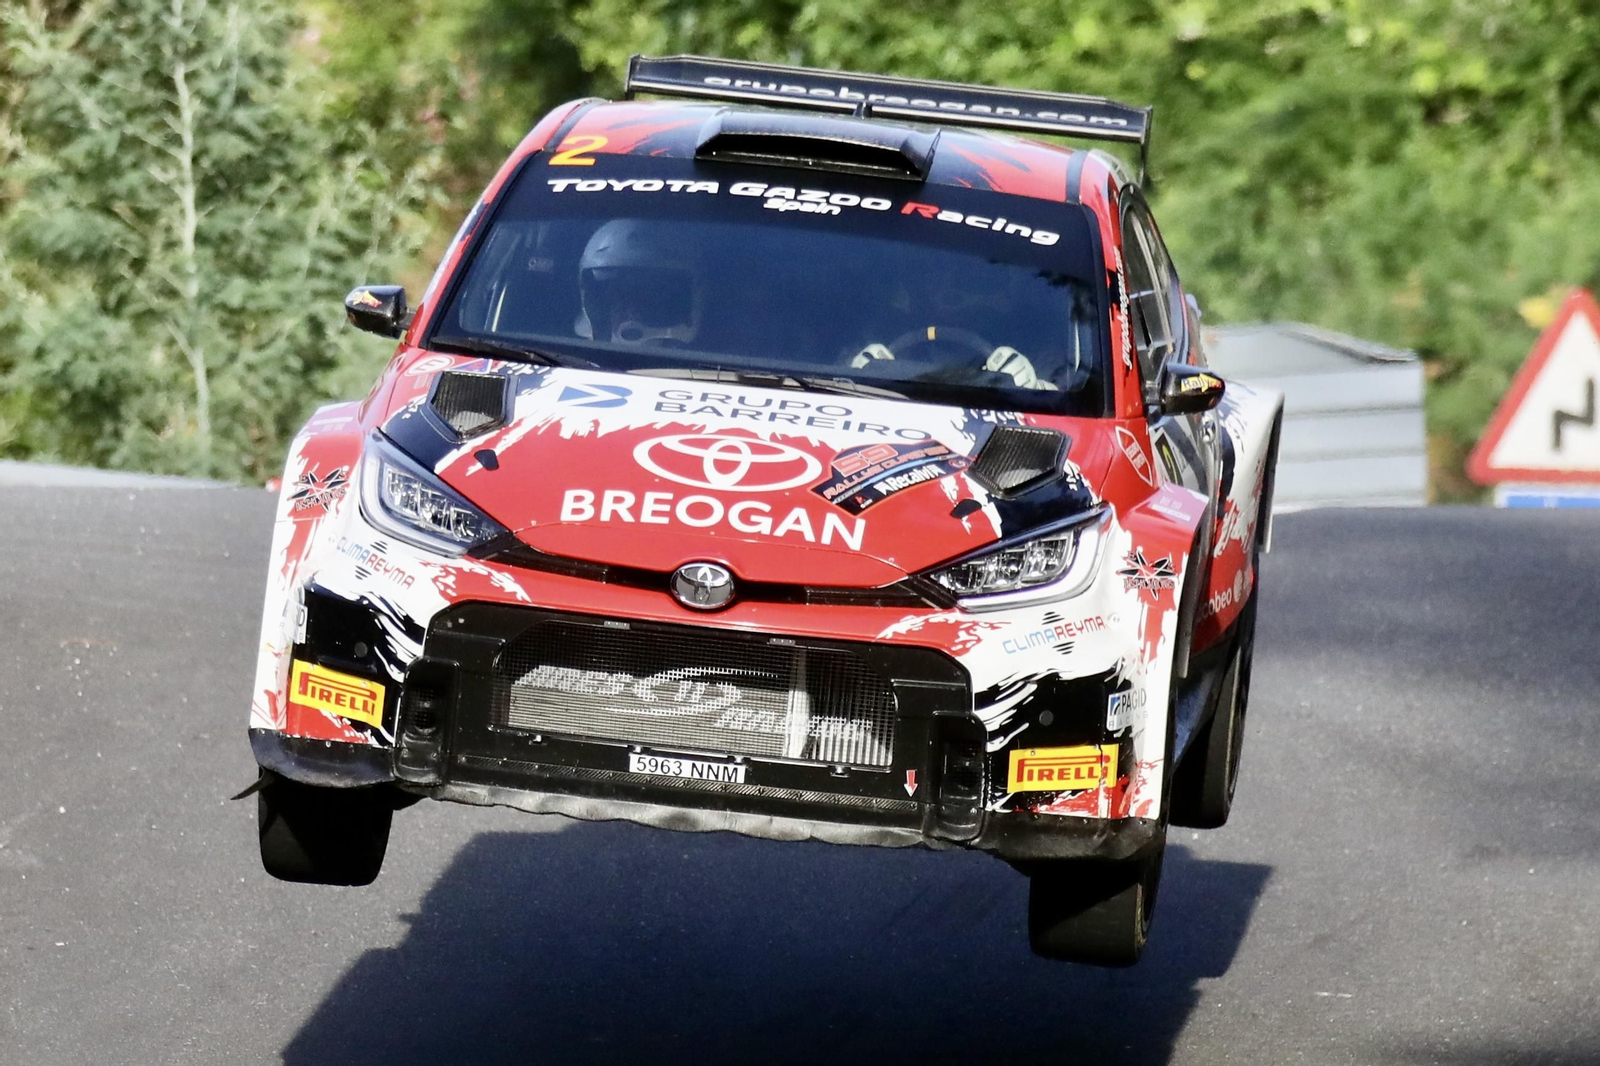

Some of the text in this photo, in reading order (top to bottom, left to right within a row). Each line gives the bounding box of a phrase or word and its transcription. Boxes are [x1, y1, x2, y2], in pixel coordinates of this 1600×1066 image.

[549, 135, 608, 166] 2
[547, 178, 1061, 246] TOYOTA GAZOO Racing
[763, 198, 842, 216] Spain
[658, 389, 853, 417] GRUPO
[654, 401, 932, 441] BARREIRO
[560, 489, 866, 551] BREOGAN
[336, 536, 416, 590] CLIMAREYMA
[1201, 587, 1233, 620] cobeo
[1002, 615, 1104, 655] CLIMAREYMA
[298, 671, 378, 716] PIRELLI
[1122, 687, 1147, 714] PAGID
[635, 757, 739, 783] 5963 NNM
[1017, 754, 1111, 784] PIRELLI
